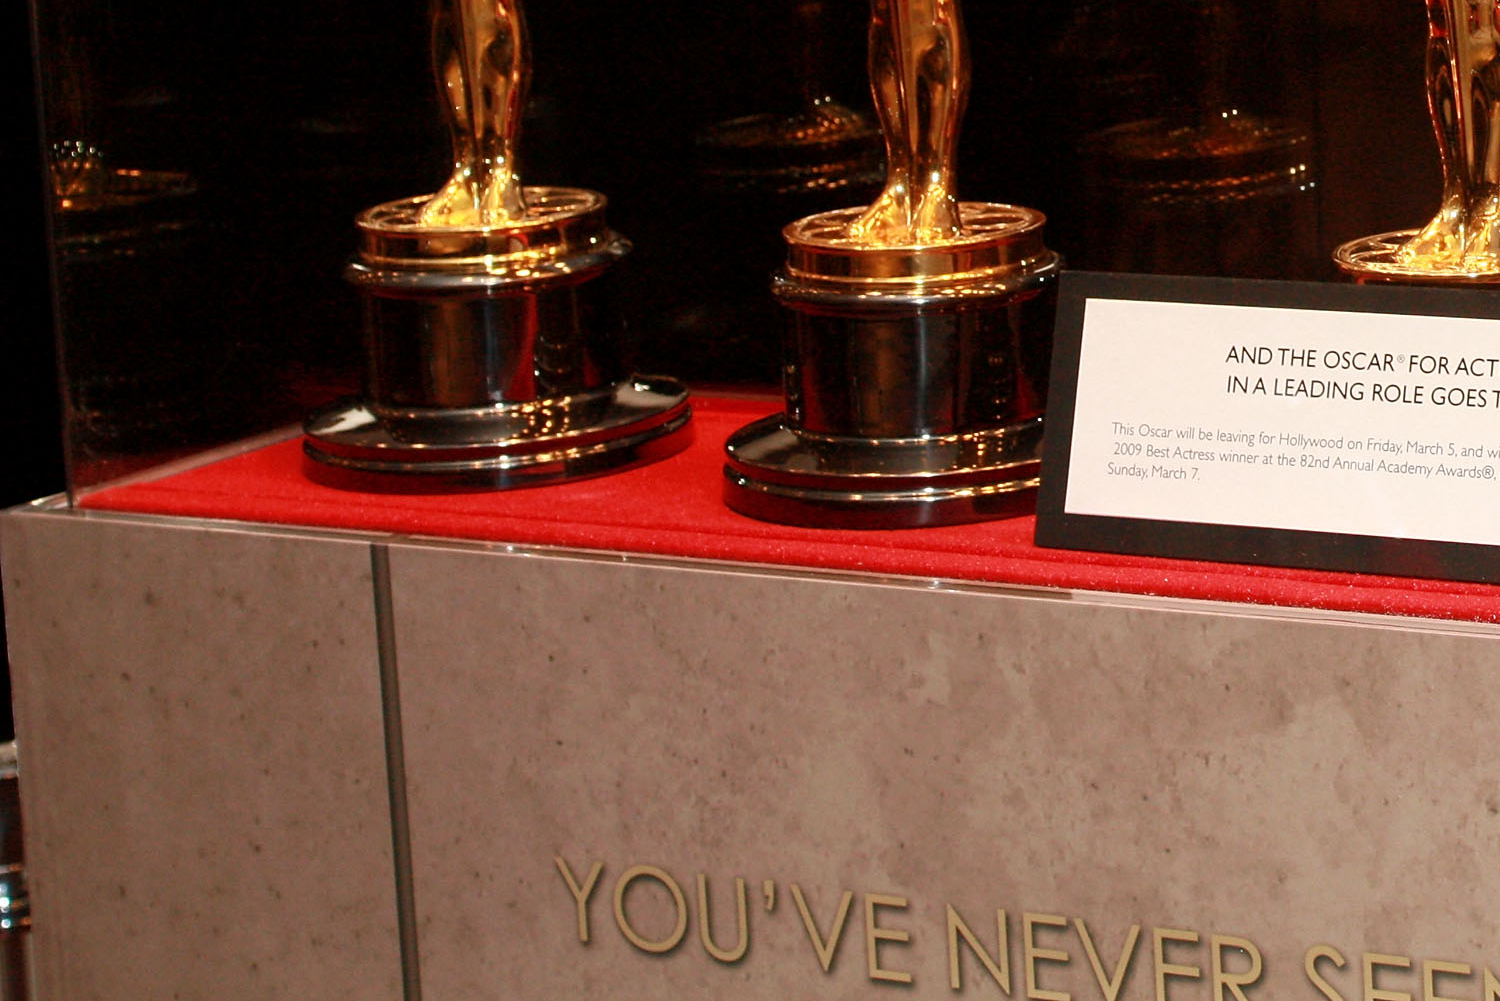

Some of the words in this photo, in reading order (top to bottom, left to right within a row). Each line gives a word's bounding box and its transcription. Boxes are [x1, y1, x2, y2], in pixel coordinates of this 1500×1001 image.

[1224, 344, 1274, 366] AND
[1276, 347, 1318, 368] THE
[1408, 354, 1451, 376] FOR
[1226, 374, 1249, 395] IN
[1251, 376, 1268, 396] A
[1273, 377, 1365, 401] LEADING
[1371, 382, 1425, 405] ROLE
[1430, 386, 1488, 409] GOES
[1111, 421, 1135, 437] This
[1138, 423, 1174, 438] Oscar
[1175, 426, 1195, 440] will
[1198, 427, 1214, 442] be
[1216, 428, 1256, 448] leaving
[1258, 430, 1277, 445] for
[1278, 432, 1344, 451] Hollywood
[1346, 440, 1363, 451] on
[1366, 437, 1403, 456] Friday,
[1406, 440, 1444, 456] March
[1447, 442, 1458, 458] 5,
[1460, 444, 1484, 458] and
[1107, 461, 1149, 481] Sunday,
[1151, 464, 1187, 480] March
[1191, 467, 1201, 481] 7.
[1113, 441, 1143, 456] 2009
[1146, 443, 1170, 459] Best
[1172, 446, 1216, 462] Actress
[1218, 453, 1260, 464] winner
[1261, 454, 1273, 465] at
[1277, 452, 1297, 467] the
[1299, 453, 1330, 469] 82nd
[1332, 456, 1375, 472] Annual
[1376, 459, 1434, 478] Academy
[554, 856, 913, 983] YOU'VE
[946, 903, 1262, 1001] NEVER
